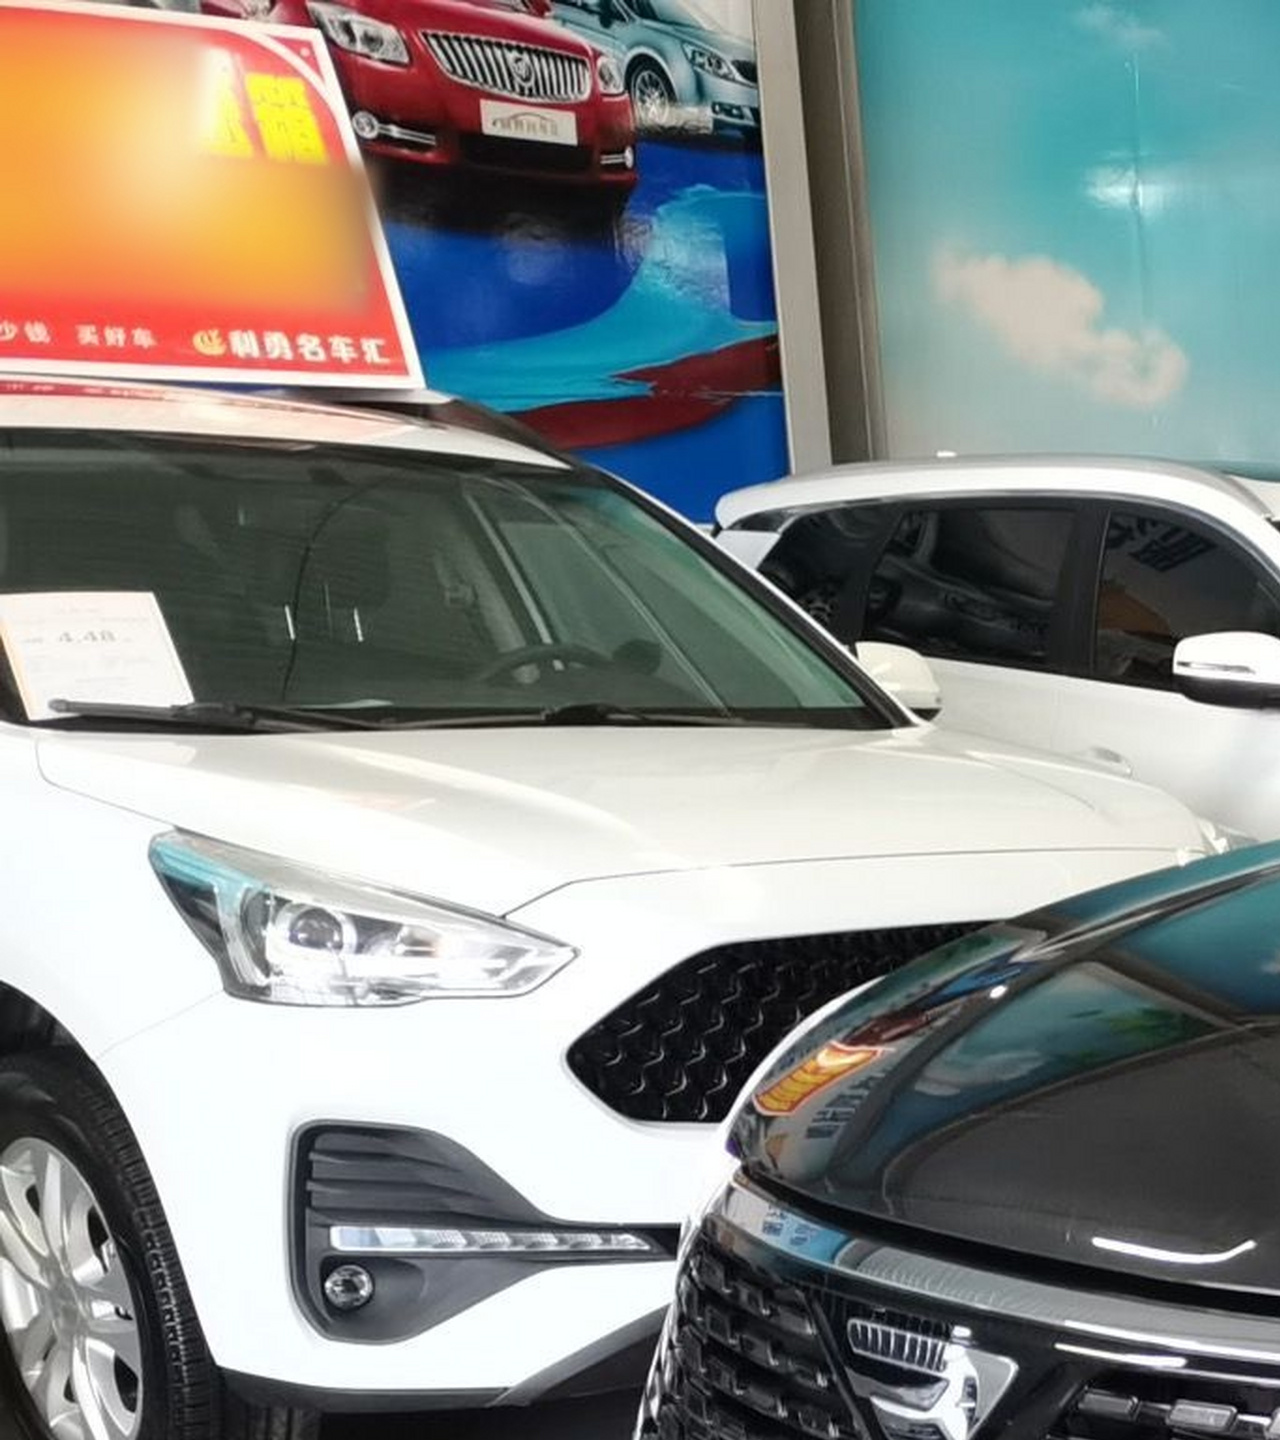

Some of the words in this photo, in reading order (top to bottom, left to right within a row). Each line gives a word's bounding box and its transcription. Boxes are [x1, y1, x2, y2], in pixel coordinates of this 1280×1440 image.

[227, 329, 391, 364] 利勇名车汇
